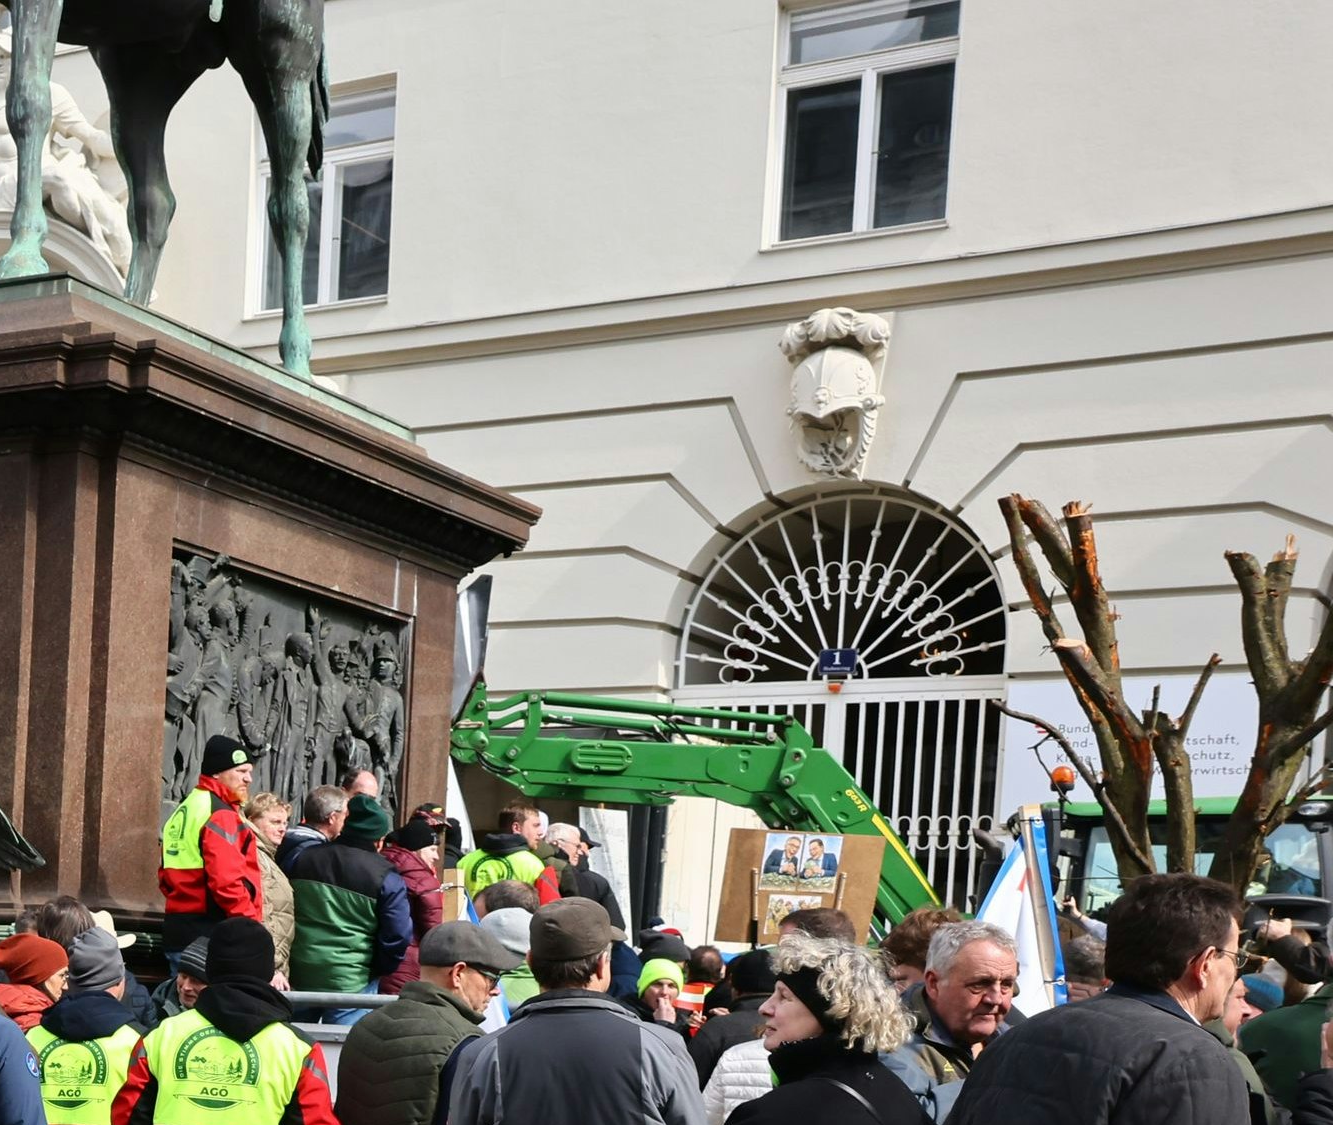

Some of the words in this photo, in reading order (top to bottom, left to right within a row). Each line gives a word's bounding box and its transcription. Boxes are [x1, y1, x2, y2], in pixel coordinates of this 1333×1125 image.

[832, 651, 841, 665] 1
[1058, 723, 1095, 734] Bund
[1186, 734, 1240, 746] tschaft,
[1191, 750, 1235, 761] chutz,
[179, 1036, 198, 1062] STIMME
[199, 1029, 216, 1037] DER
[57, 1086, 81, 1097] AGÖ
[200, 1085, 229, 1097] AGÖ
